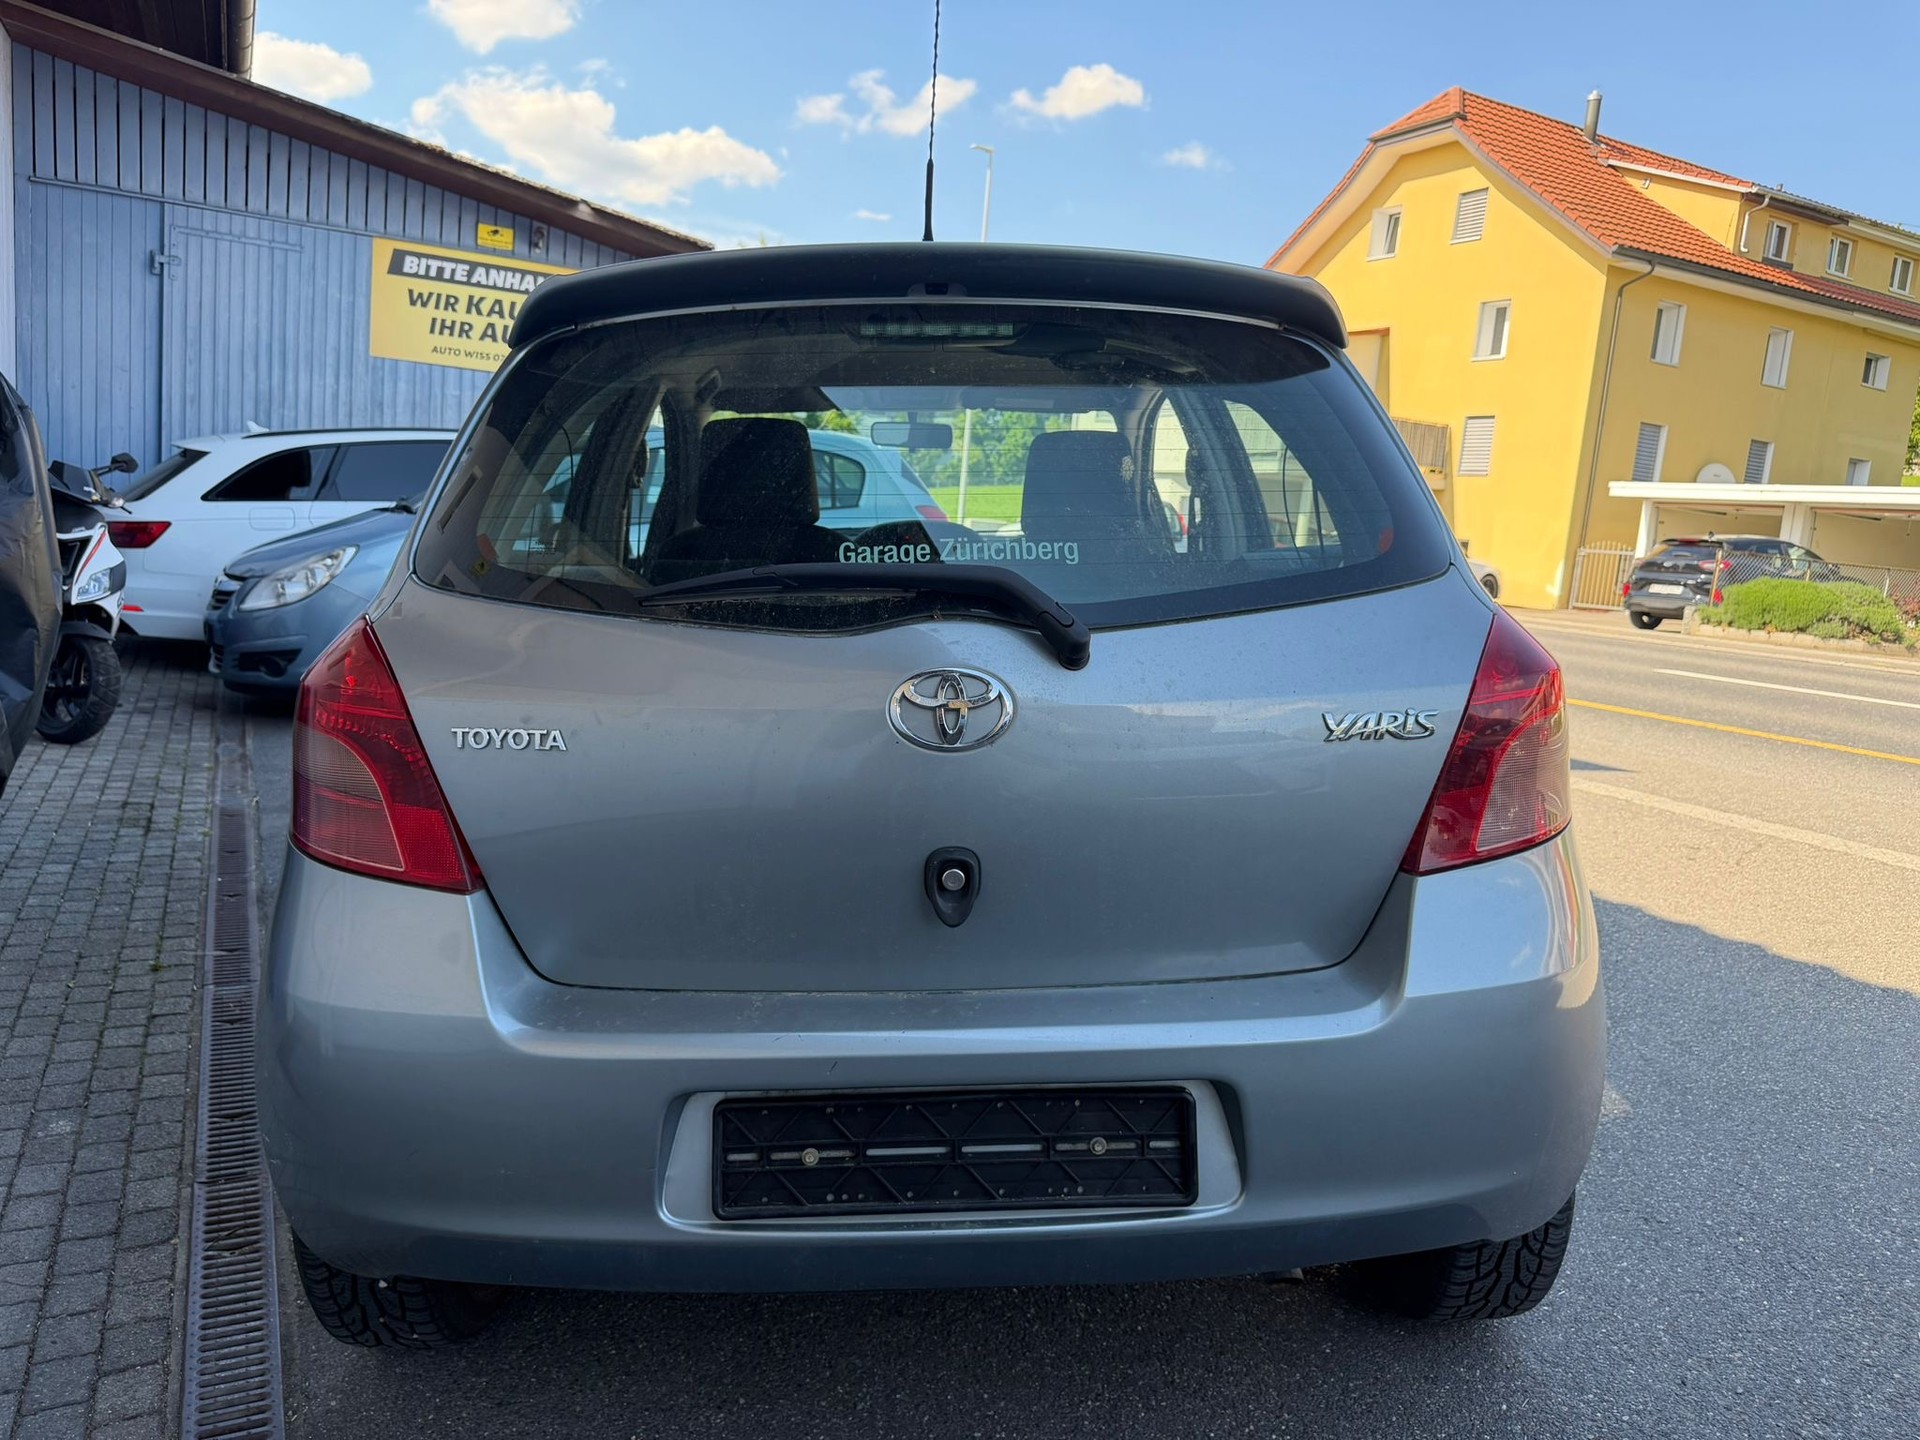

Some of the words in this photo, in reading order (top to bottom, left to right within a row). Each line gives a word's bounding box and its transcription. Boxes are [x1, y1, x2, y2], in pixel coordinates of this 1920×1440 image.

[403, 255, 468, 281] BITTE
[407, 289, 460, 313] WIR
[429, 317, 474, 341] IHR
[431, 345, 461, 357] AUTO
[838, 541, 931, 565] Garage
[939, 538, 1080, 565] Zürichberg
[451, 727, 568, 751] TOYOTA
